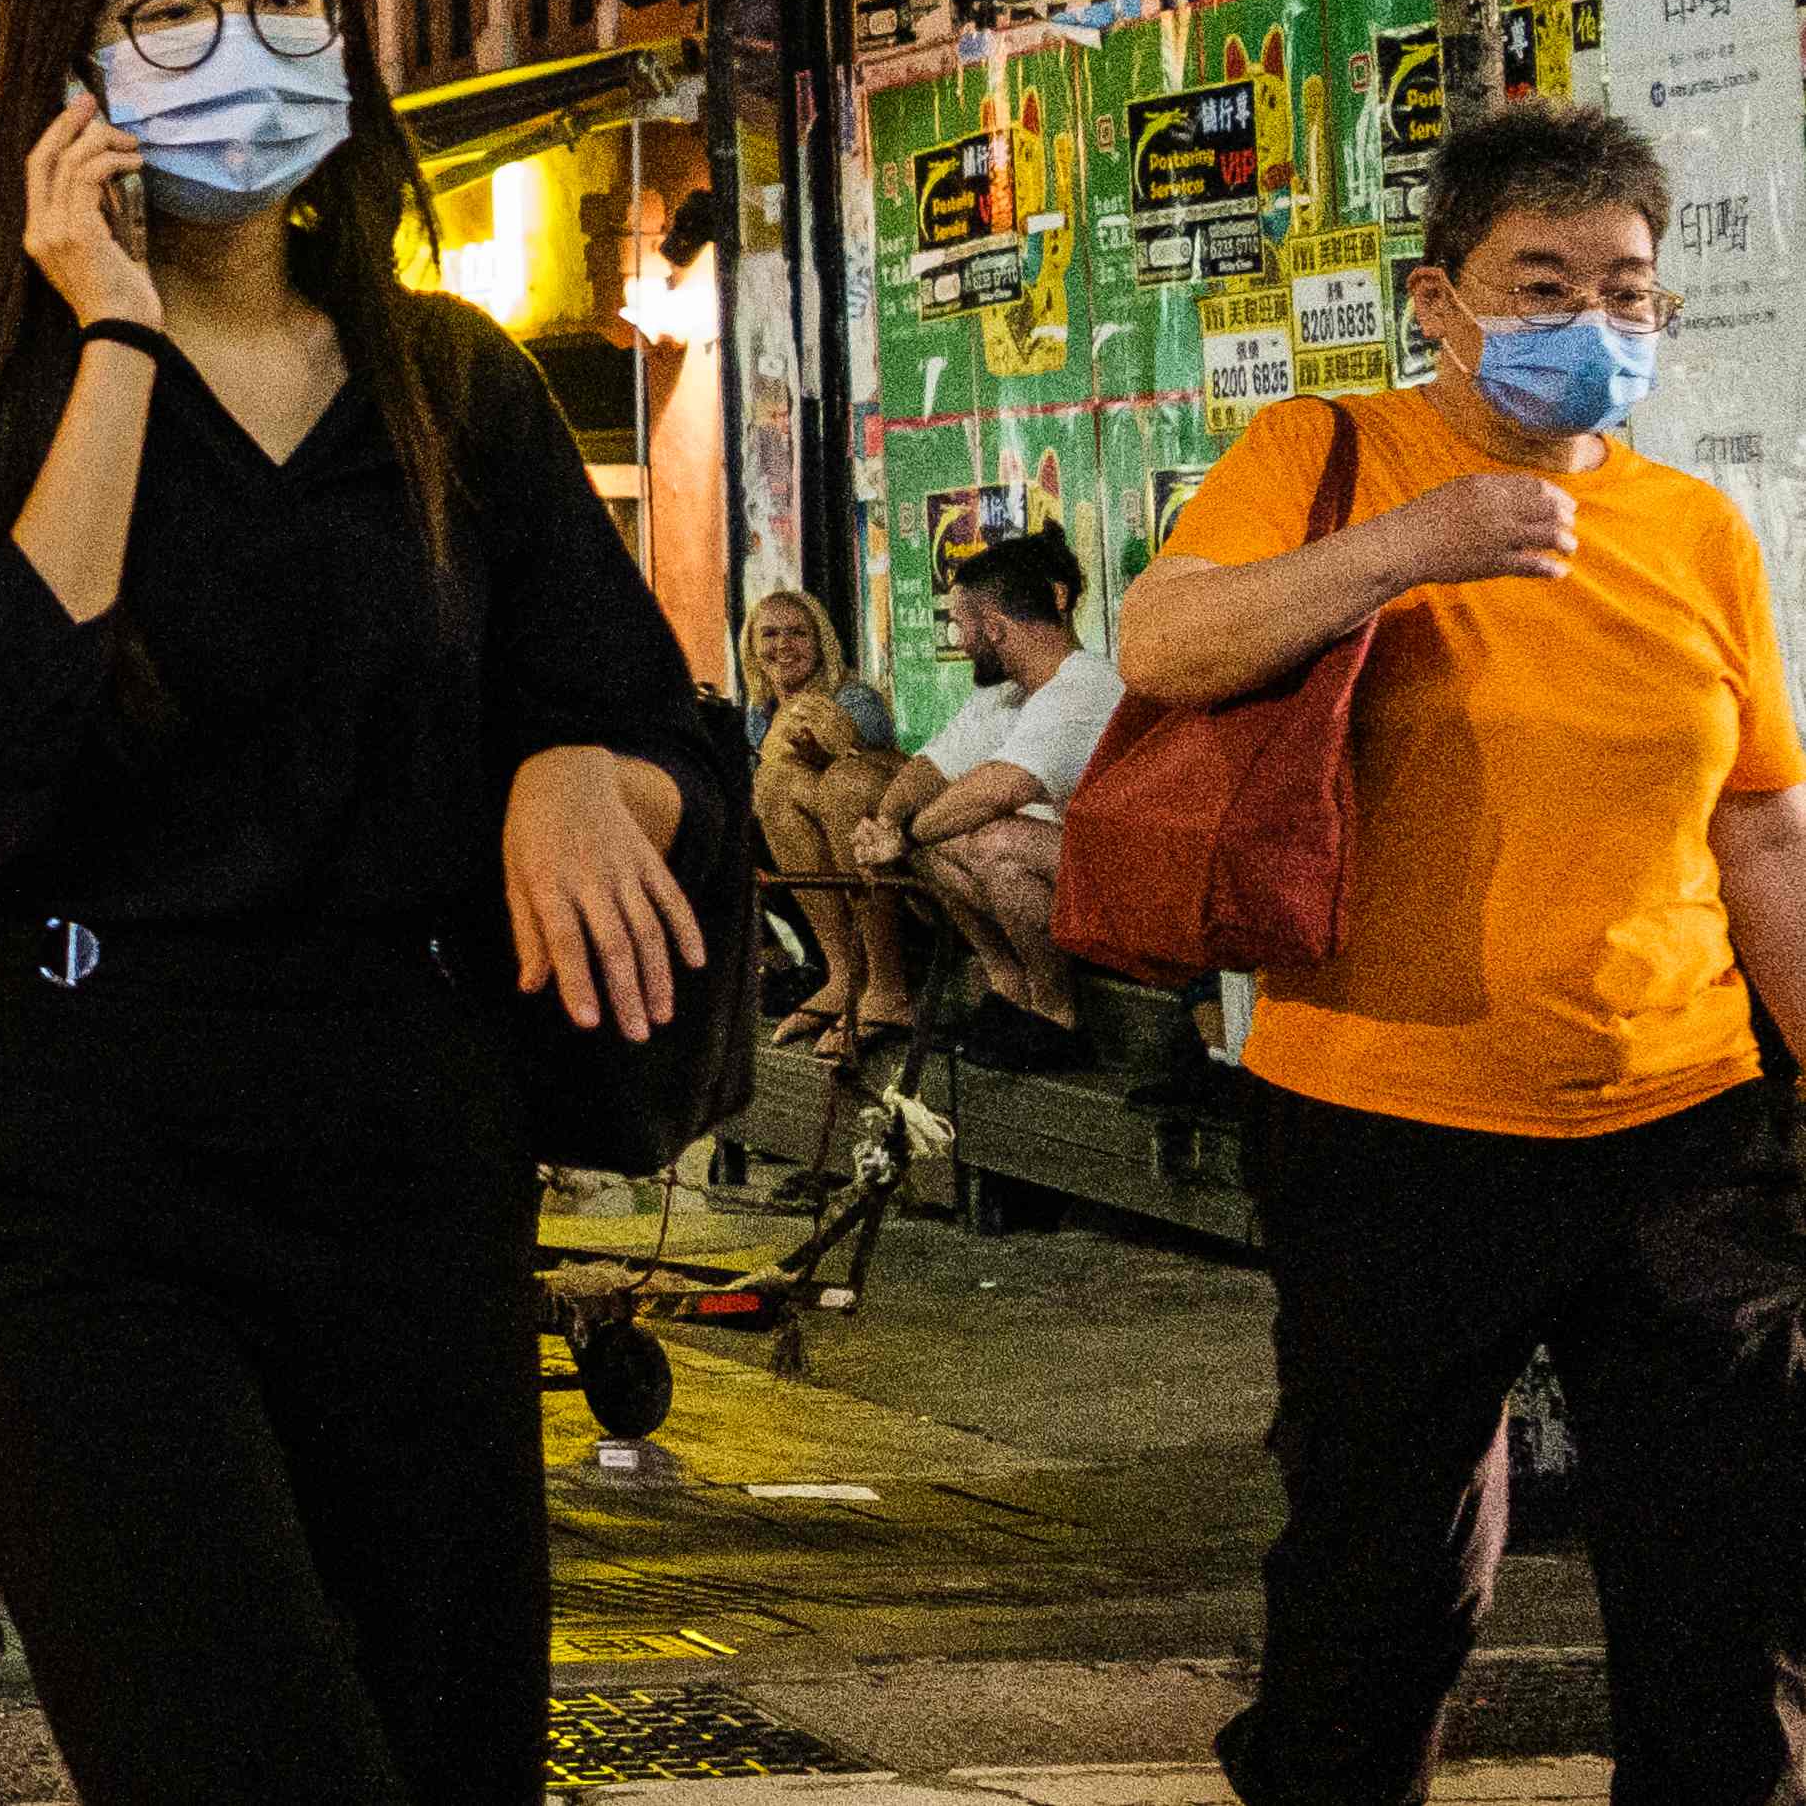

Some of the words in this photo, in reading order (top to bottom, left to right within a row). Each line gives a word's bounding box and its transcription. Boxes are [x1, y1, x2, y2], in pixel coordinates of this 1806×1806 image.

[1149, 149, 1216, 171] Postering
[1219, 147, 1256, 185] VIP
[1300, 309, 1334, 343] 8200
[1337, 301, 1378, 338] 6835
[1212, 367, 1248, 401] 8200
[1252, 360, 1289, 397] 6835
